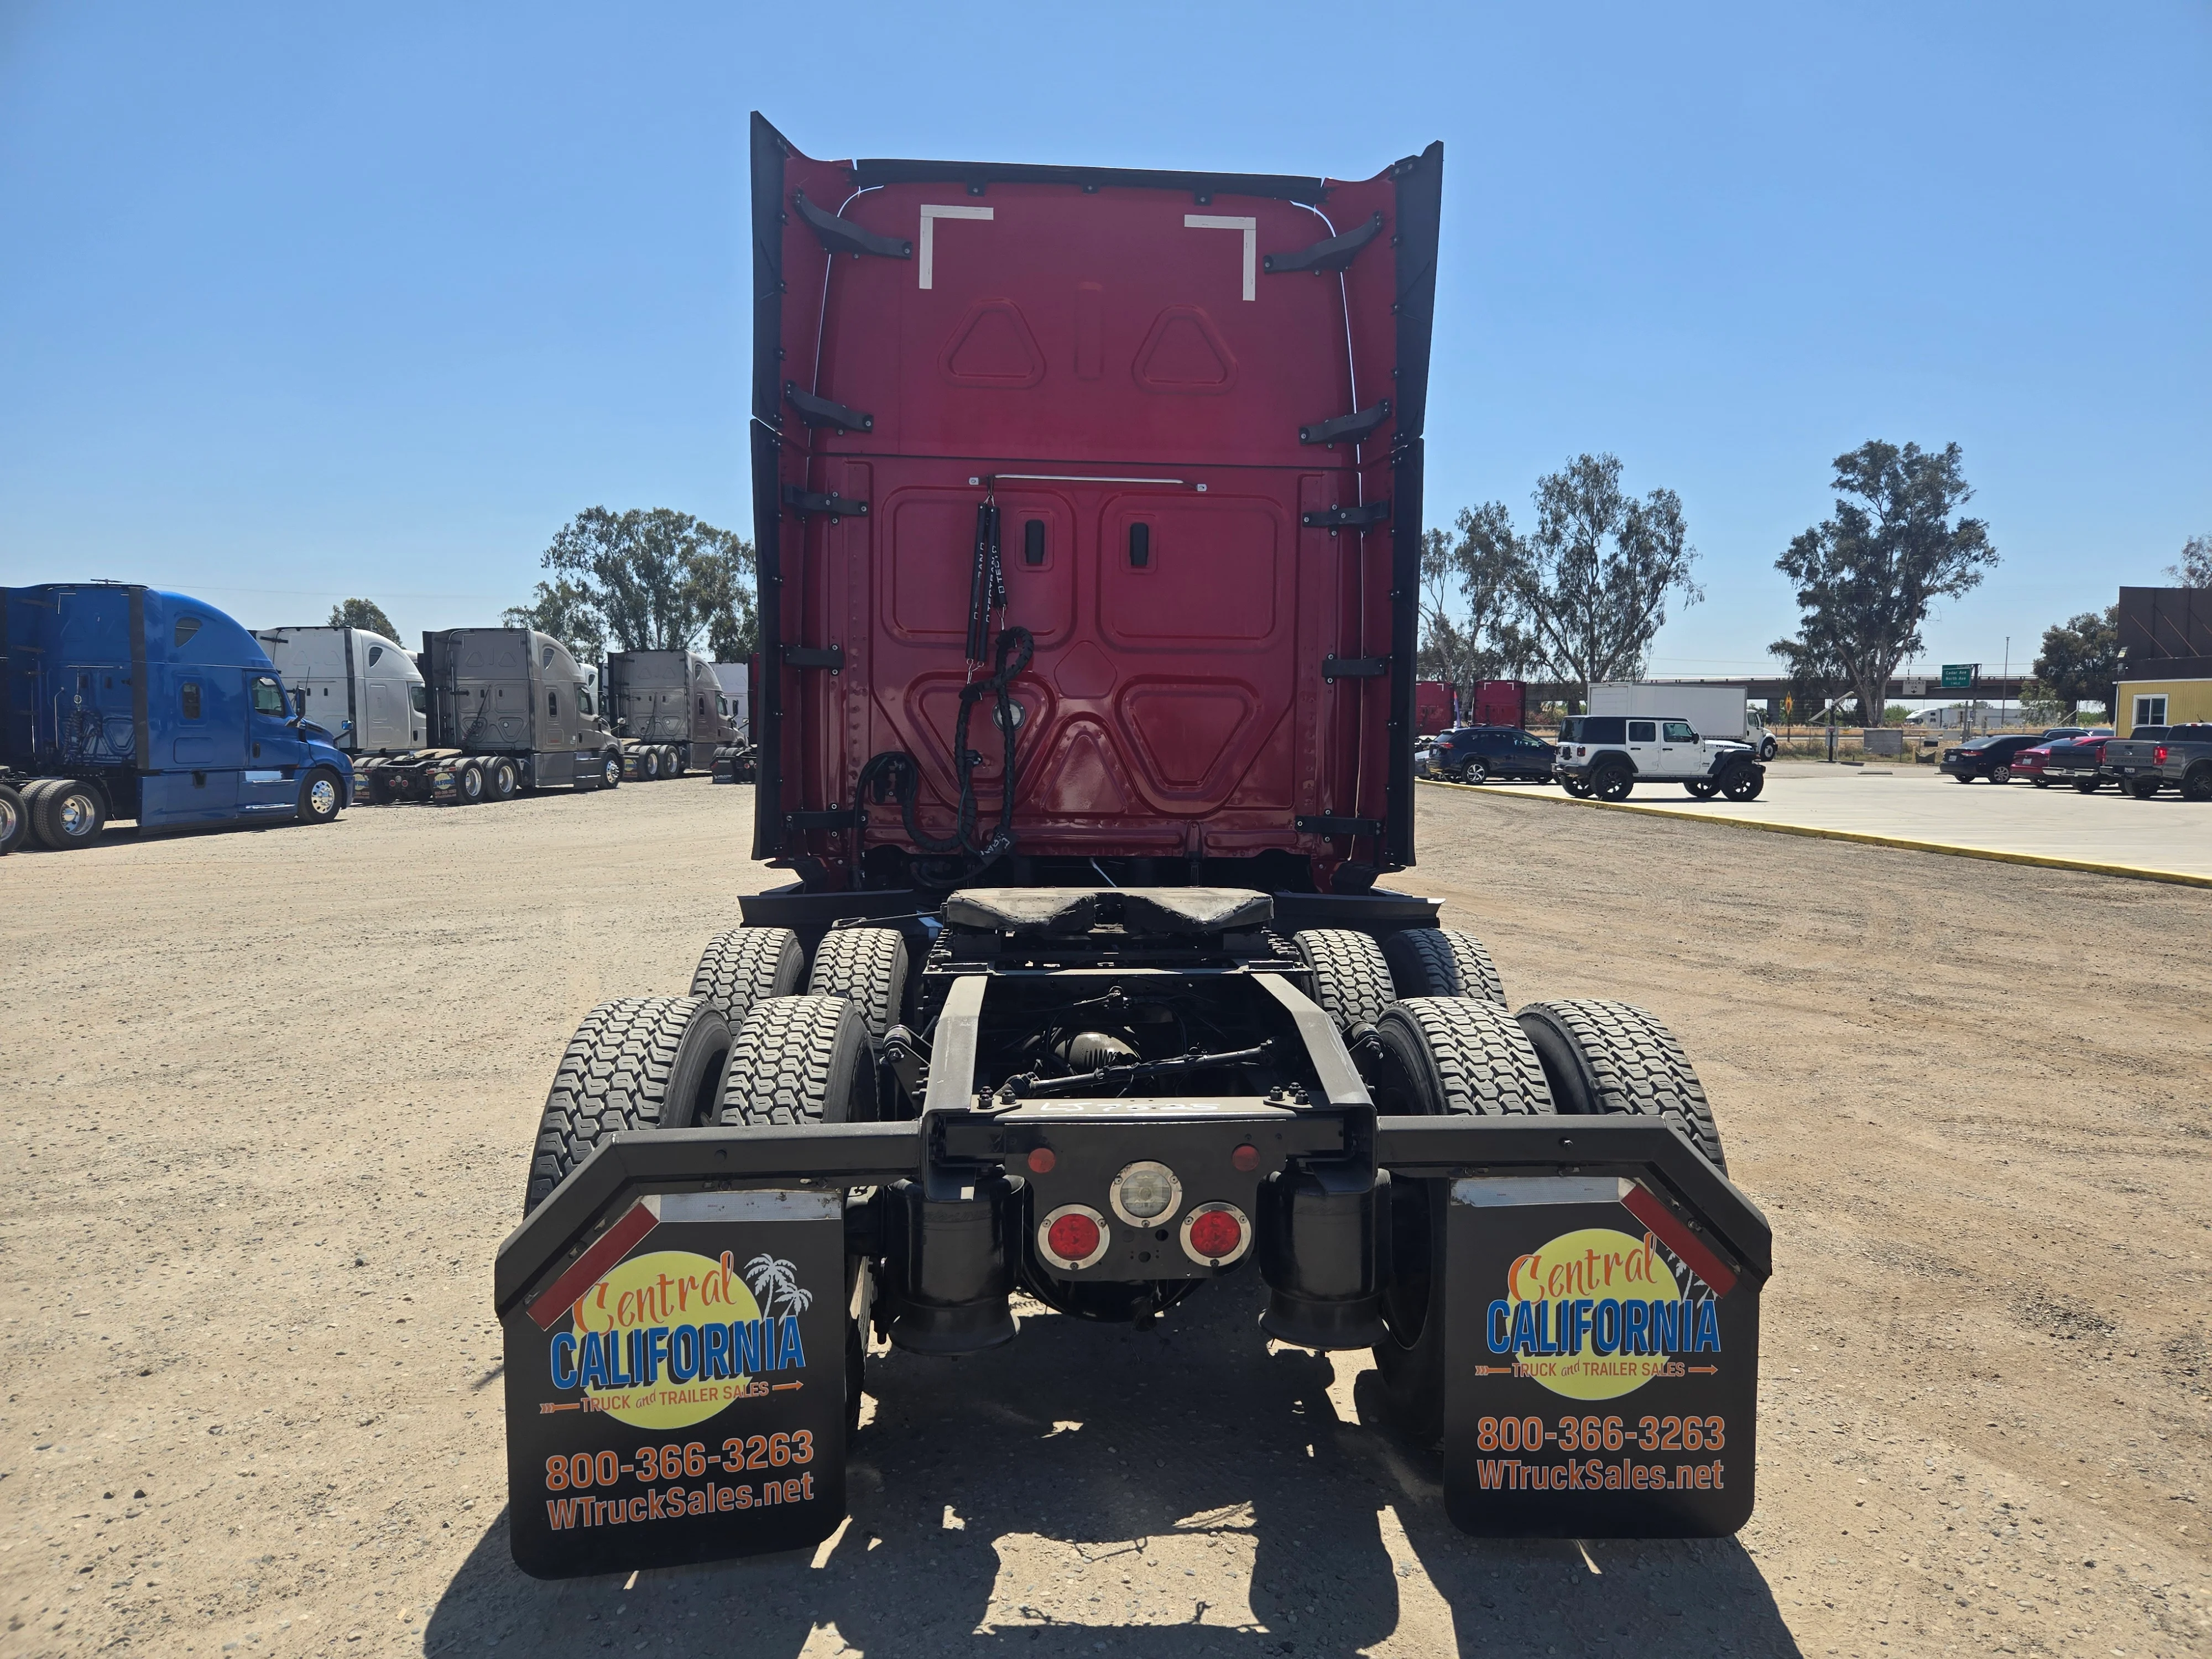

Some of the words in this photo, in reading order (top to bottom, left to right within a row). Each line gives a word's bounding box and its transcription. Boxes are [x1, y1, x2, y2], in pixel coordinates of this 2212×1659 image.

[573, 1250, 737, 1336] Central
[1507, 1231, 1658, 1305] Central
[550, 1314, 806, 1390] CALIFORNIA
[1486, 1298, 1721, 1354] CALIFORNIA
[581, 1395, 630, 1413] TRUCK
[635, 1389, 656, 1409] and
[659, 1386, 719, 1406] TRAILER
[723, 1381, 769, 1400] SALES
[1511, 1362, 1557, 1378] TRUCK
[1561, 1358, 1580, 1376] and
[1582, 1362, 1637, 1376] TRAILER
[1641, 1362, 1686, 1377] SALES
[545, 1429, 814, 1491] 800-366-3263
[1477, 1415, 1725, 1452] 800-366-3263
[546, 1471, 815, 1531] WTruckSales.net
[1476, 1458, 1725, 1490] WTruckSales.net
